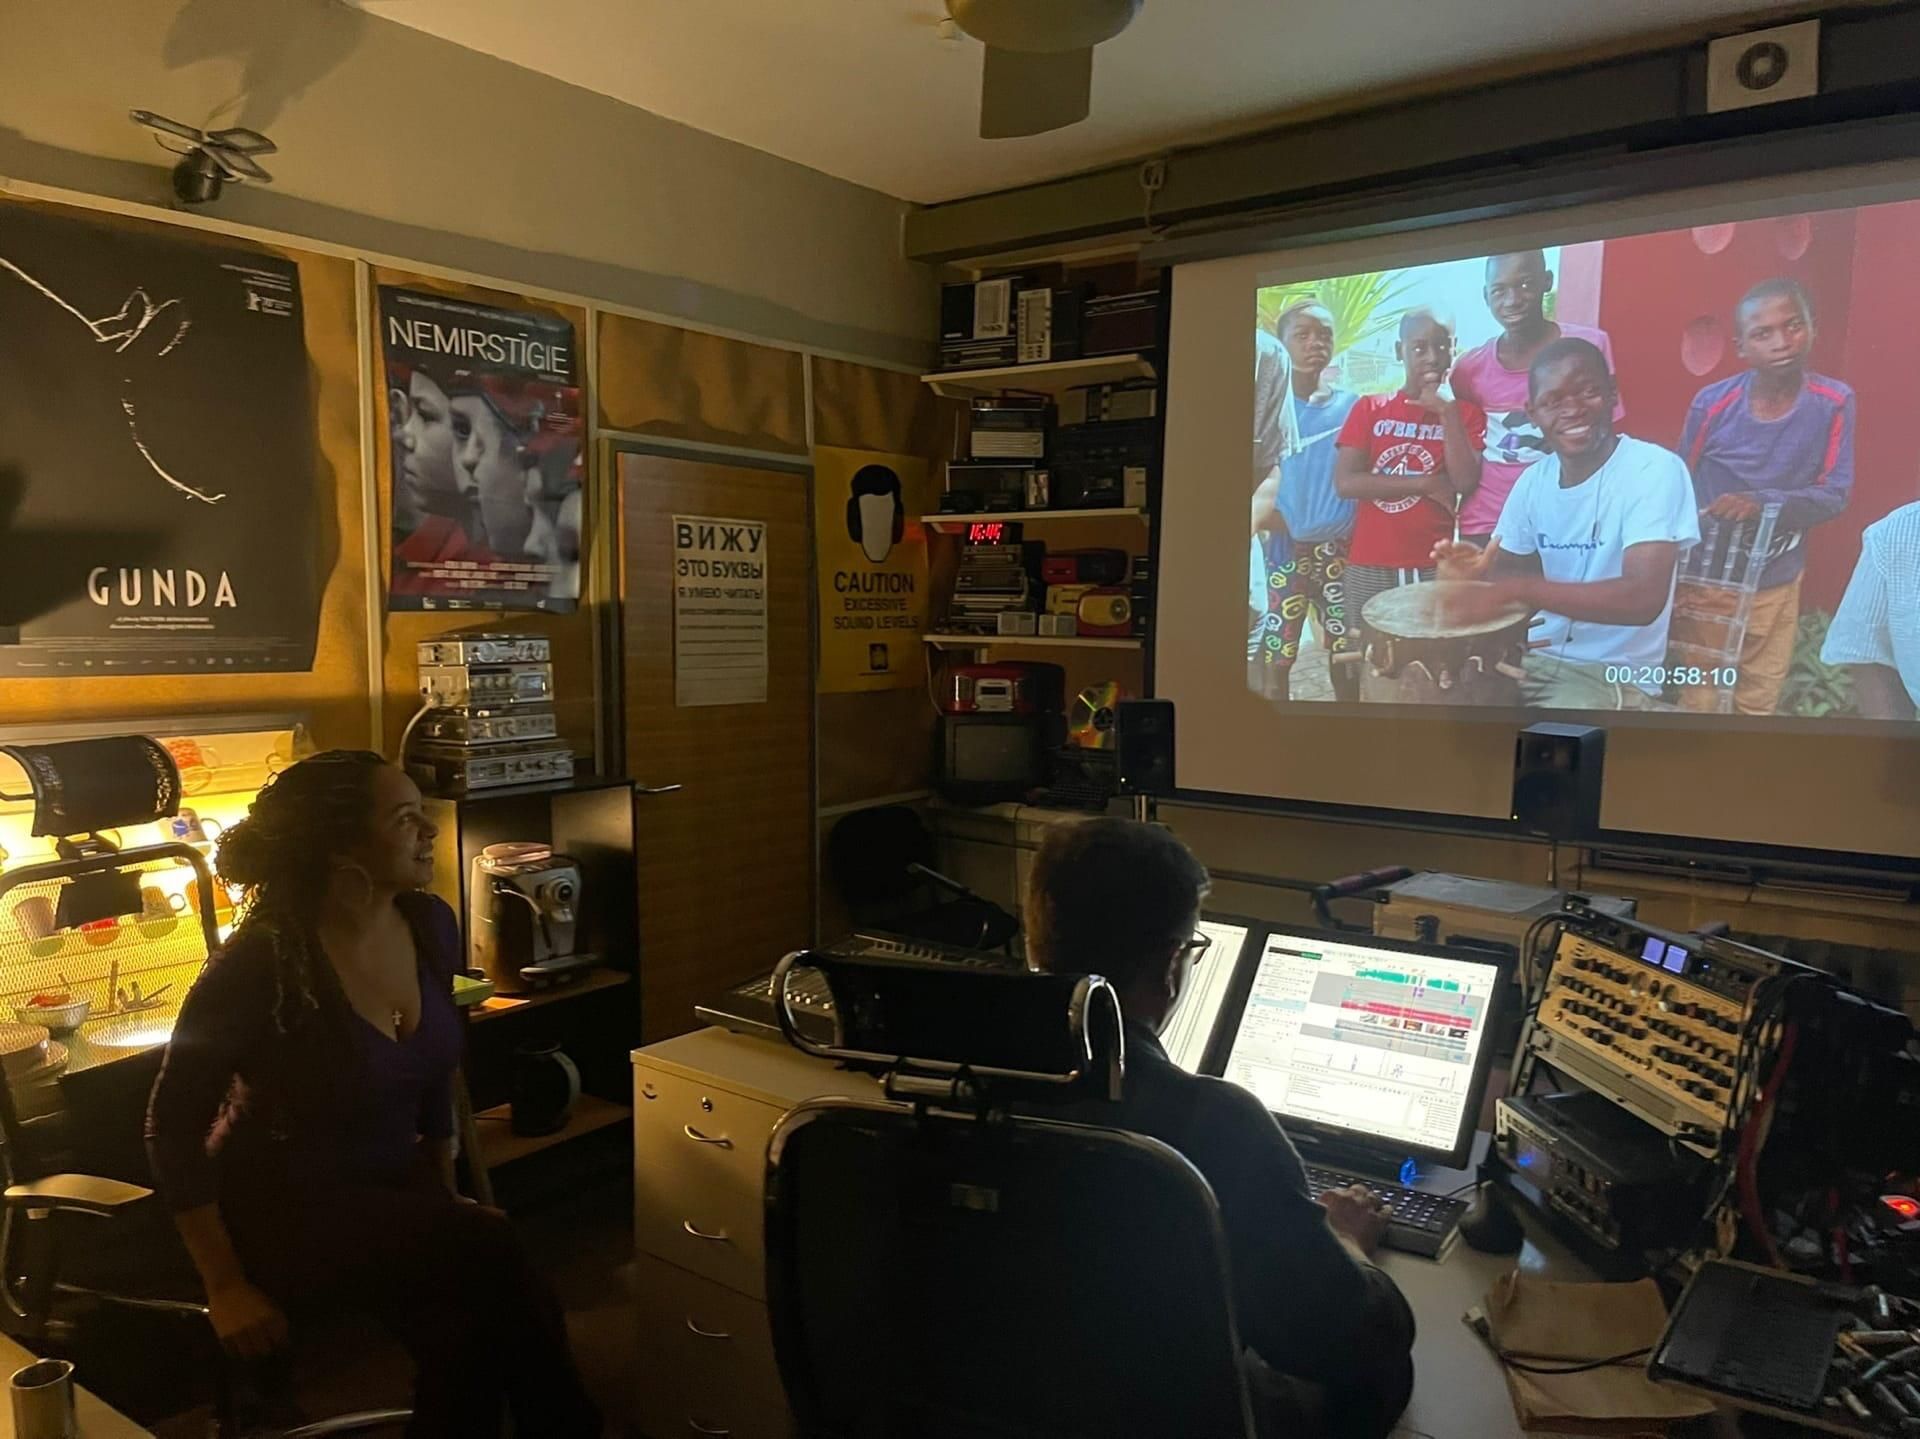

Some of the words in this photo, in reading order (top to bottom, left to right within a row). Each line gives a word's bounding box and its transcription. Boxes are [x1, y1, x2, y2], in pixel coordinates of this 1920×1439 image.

[389, 317, 569, 374] NEMIRSTĪGIE
[677, 524, 762, 552] ВИЖУ
[677, 559, 709, 577] ЭТО
[712, 560, 763, 579] БУКВЫ
[87, 566, 237, 607] GUNDA
[834, 571, 914, 593] CAUTION
[844, 598, 907, 611] EXCESSIVE
[833, 616, 874, 629] SOUND
[877, 615, 919, 628] LEVELS
[1605, 665, 1737, 686] 00:20:58:10
